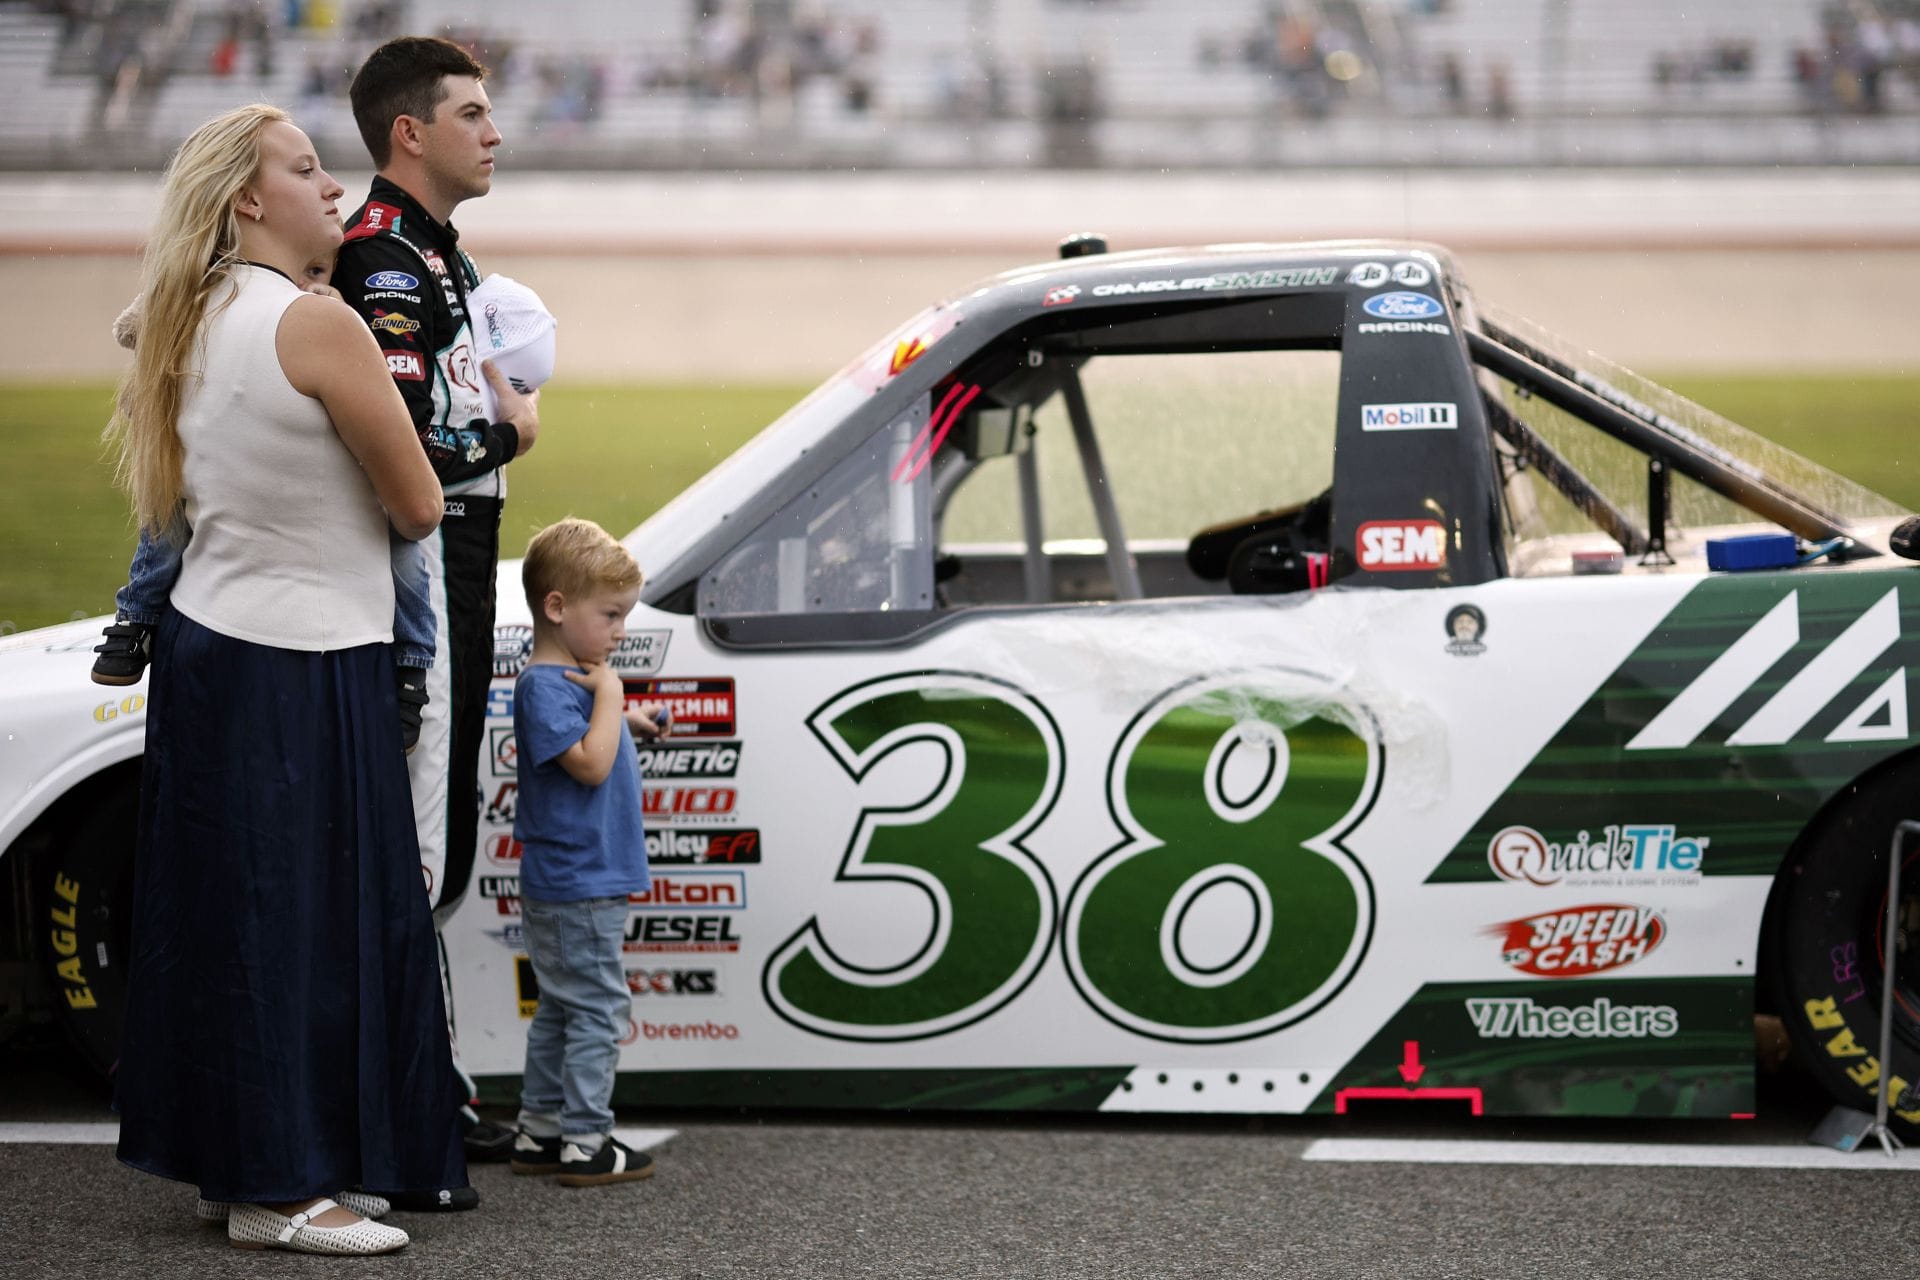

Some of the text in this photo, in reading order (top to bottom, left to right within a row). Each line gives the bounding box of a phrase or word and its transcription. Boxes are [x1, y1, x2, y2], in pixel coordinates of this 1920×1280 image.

[375, 274, 408, 287] Ford
[1203, 267, 1340, 291] SMITH
[364, 291, 421, 304] RACING
[1378, 296, 1429, 314] Ford
[372, 318, 419, 332] SUNOCO
[1358, 322, 1450, 335] RACING
[386, 355, 421, 375] SEM
[1365, 408, 1424, 425] Mobil
[1362, 527, 1441, 564] SEM
[619, 636, 654, 652] CAR
[605, 655, 652, 669] RUCK
[638, 744, 738, 772] OMETIC
[642, 788, 737, 815] LICO
[645, 829, 709, 863] olley
[762, 669, 1386, 1046] 38
[1492, 826, 1700, 886] QuickTie
[51, 871, 98, 1009] EAGLE
[624, 916, 741, 942] JESEL
[1529, 907, 1652, 948] SPEEDY
[625, 969, 716, 995] OOKS
[642, 1019, 739, 1040] brembo
[1466, 998, 1678, 1037] Wheelers
